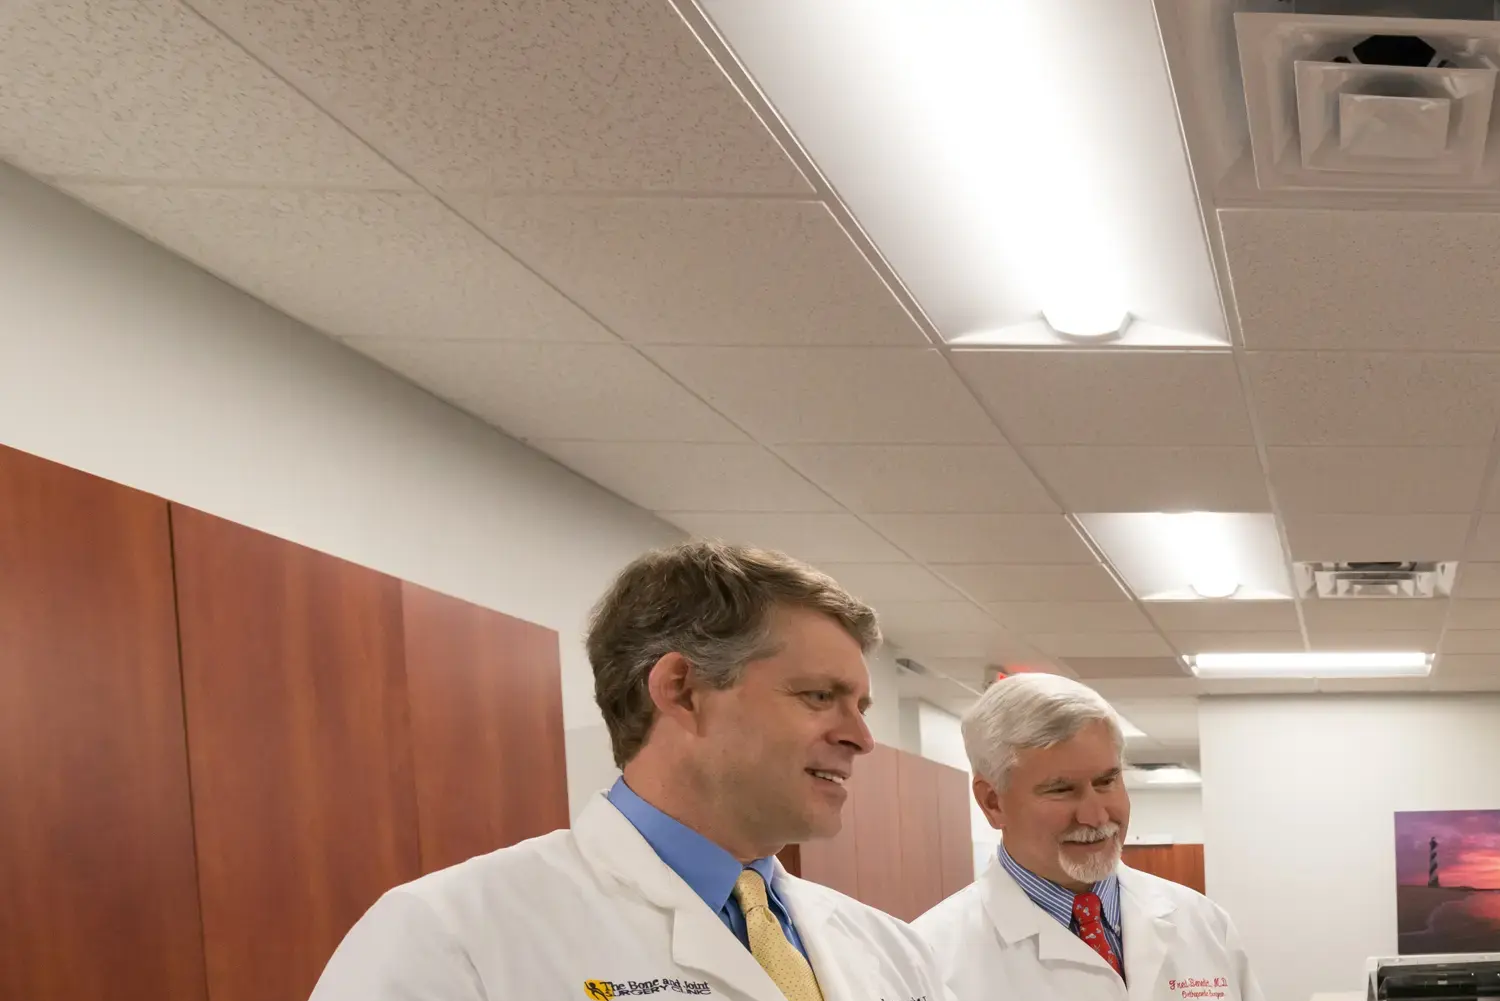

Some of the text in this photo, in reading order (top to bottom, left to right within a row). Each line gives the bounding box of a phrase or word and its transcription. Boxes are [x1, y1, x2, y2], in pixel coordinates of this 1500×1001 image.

[600, 978, 710, 991] The Bone and Joint
[605, 985, 668, 997] SURGERY
